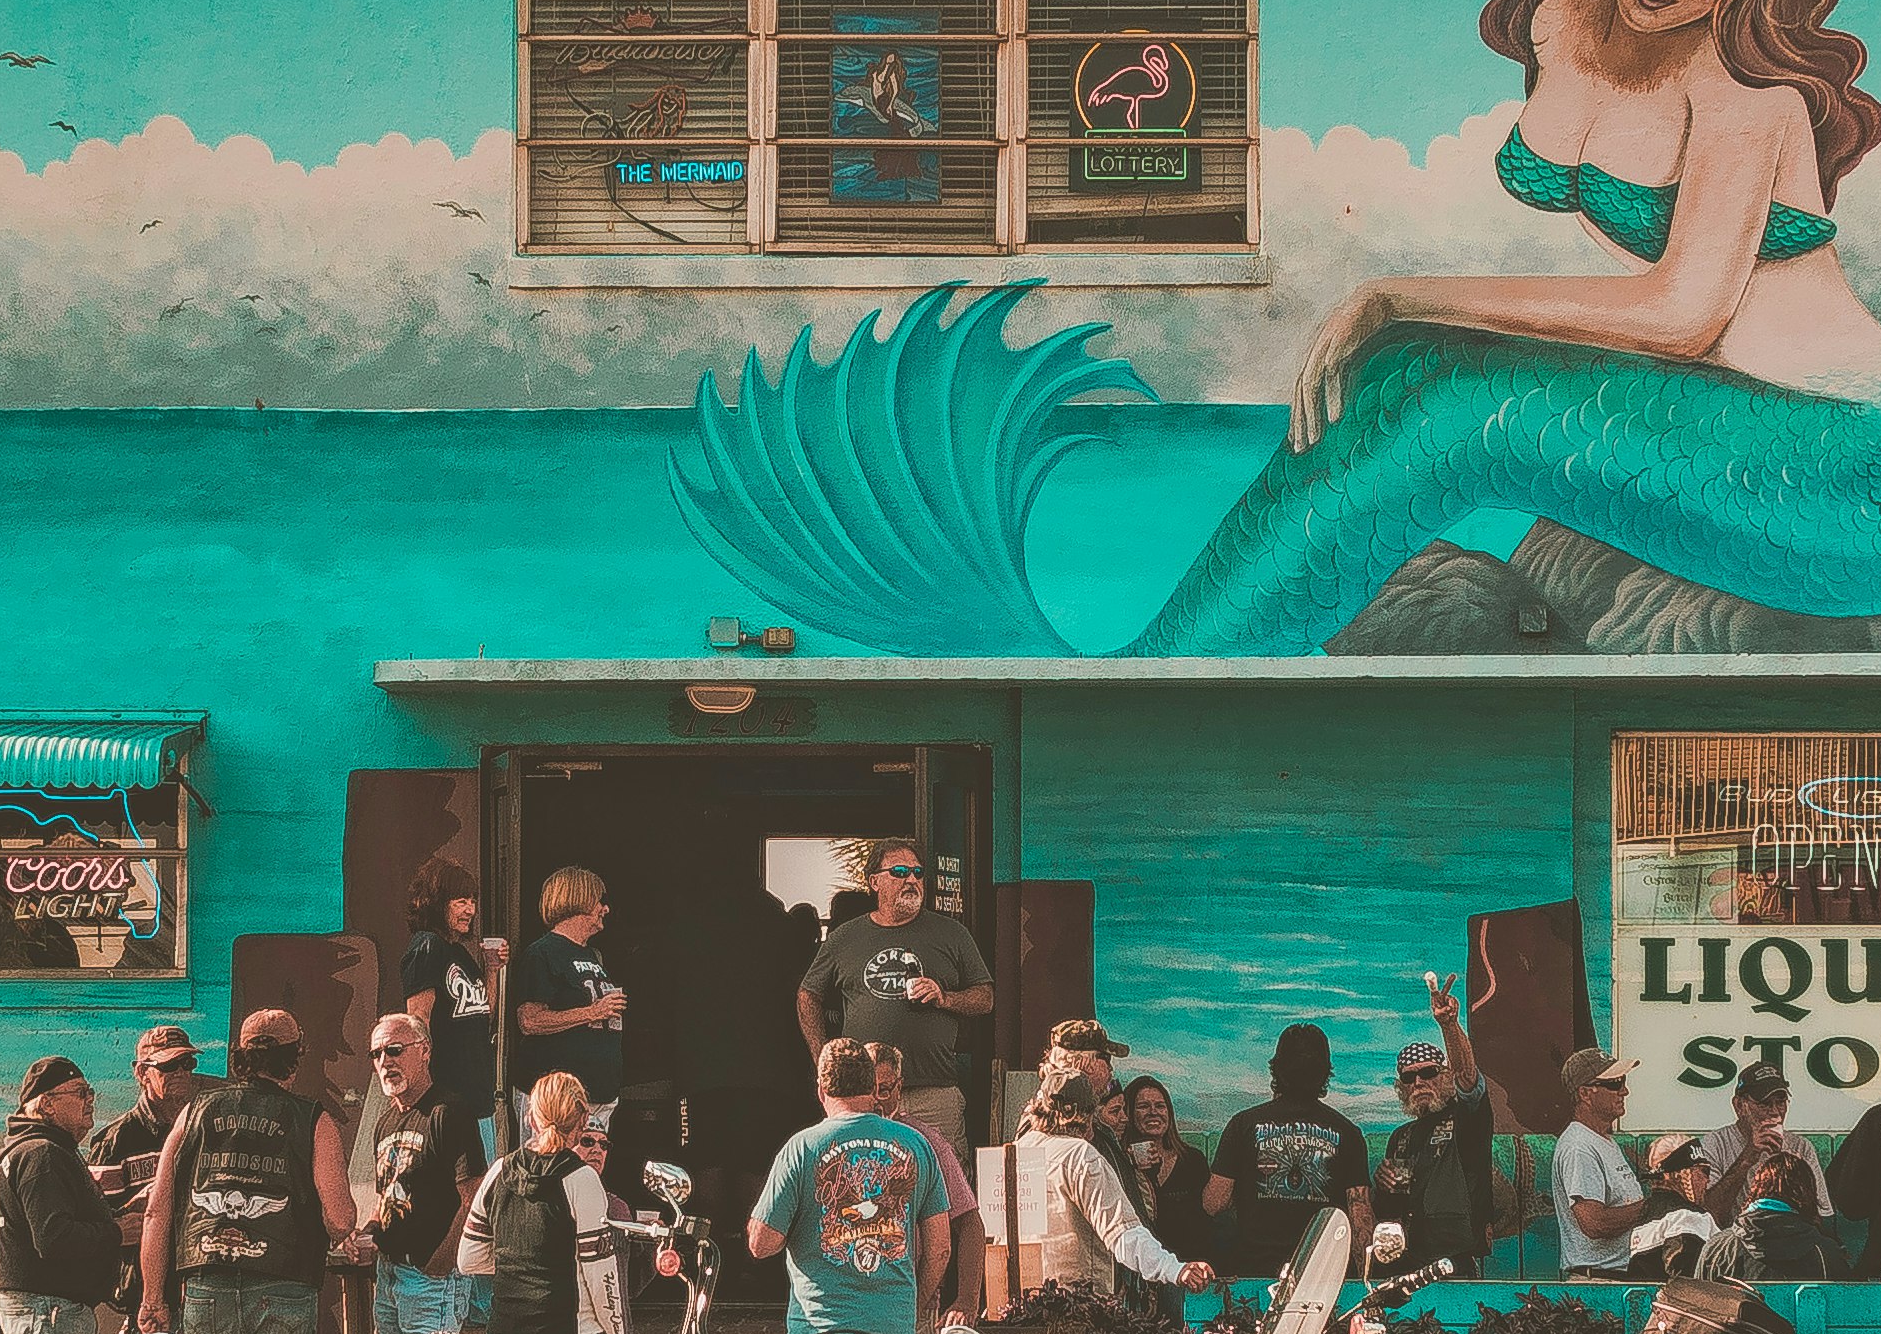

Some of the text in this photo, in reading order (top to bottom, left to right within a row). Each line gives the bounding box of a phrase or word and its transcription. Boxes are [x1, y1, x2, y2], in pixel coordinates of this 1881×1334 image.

[616, 161, 744, 184] THE MERMAID
[1090, 155, 1179, 174] LOTTERY
[5, 855, 130, 893] Coors
[14, 892, 126, 920] LIGHT
[821, 1138, 871, 1164] DAYTONA
